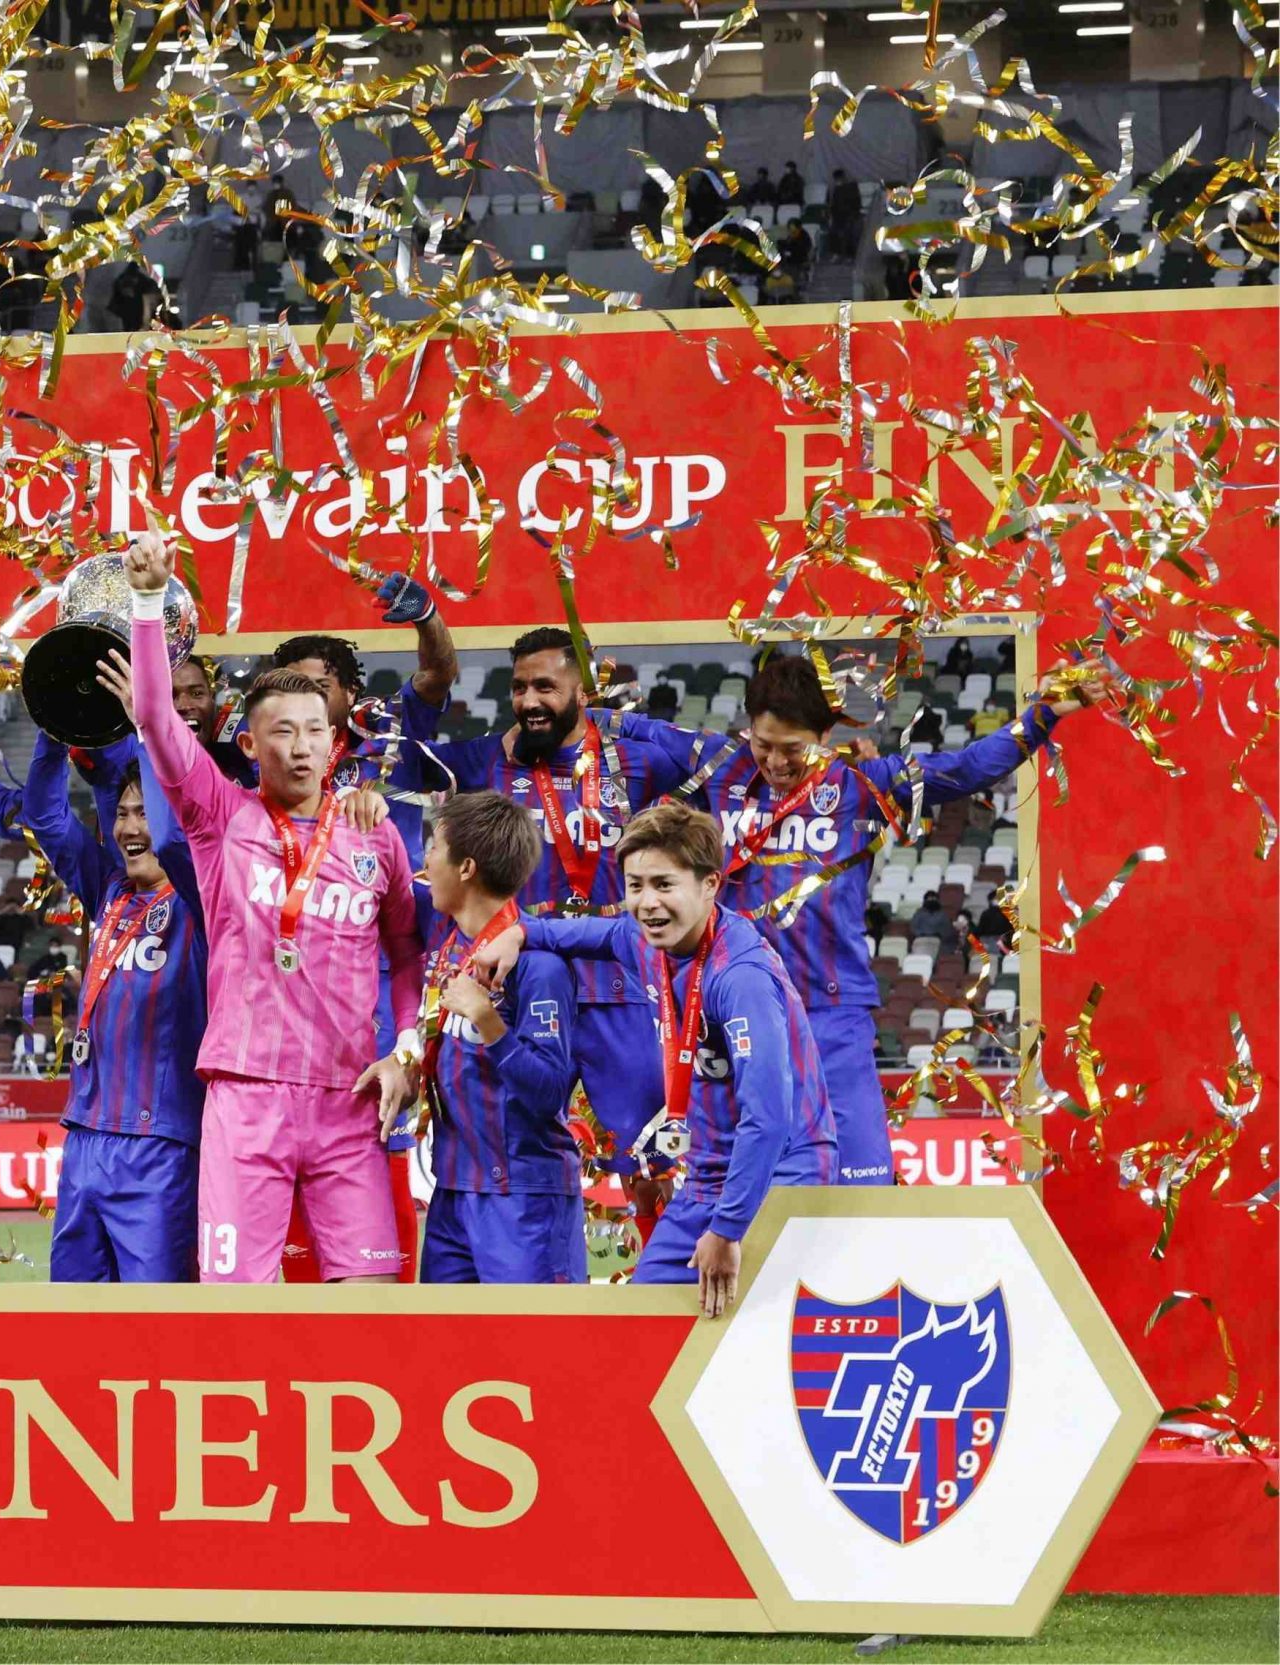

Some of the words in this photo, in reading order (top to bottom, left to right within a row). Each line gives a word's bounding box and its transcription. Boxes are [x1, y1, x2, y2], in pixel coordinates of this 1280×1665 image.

[108, 436, 496, 542] Levain
[518, 454, 726, 533] CUP
[543, 792, 558, 820] Levain
[203, 1222, 237, 1275] 13
[813, 1318, 880, 1334] ESTD
